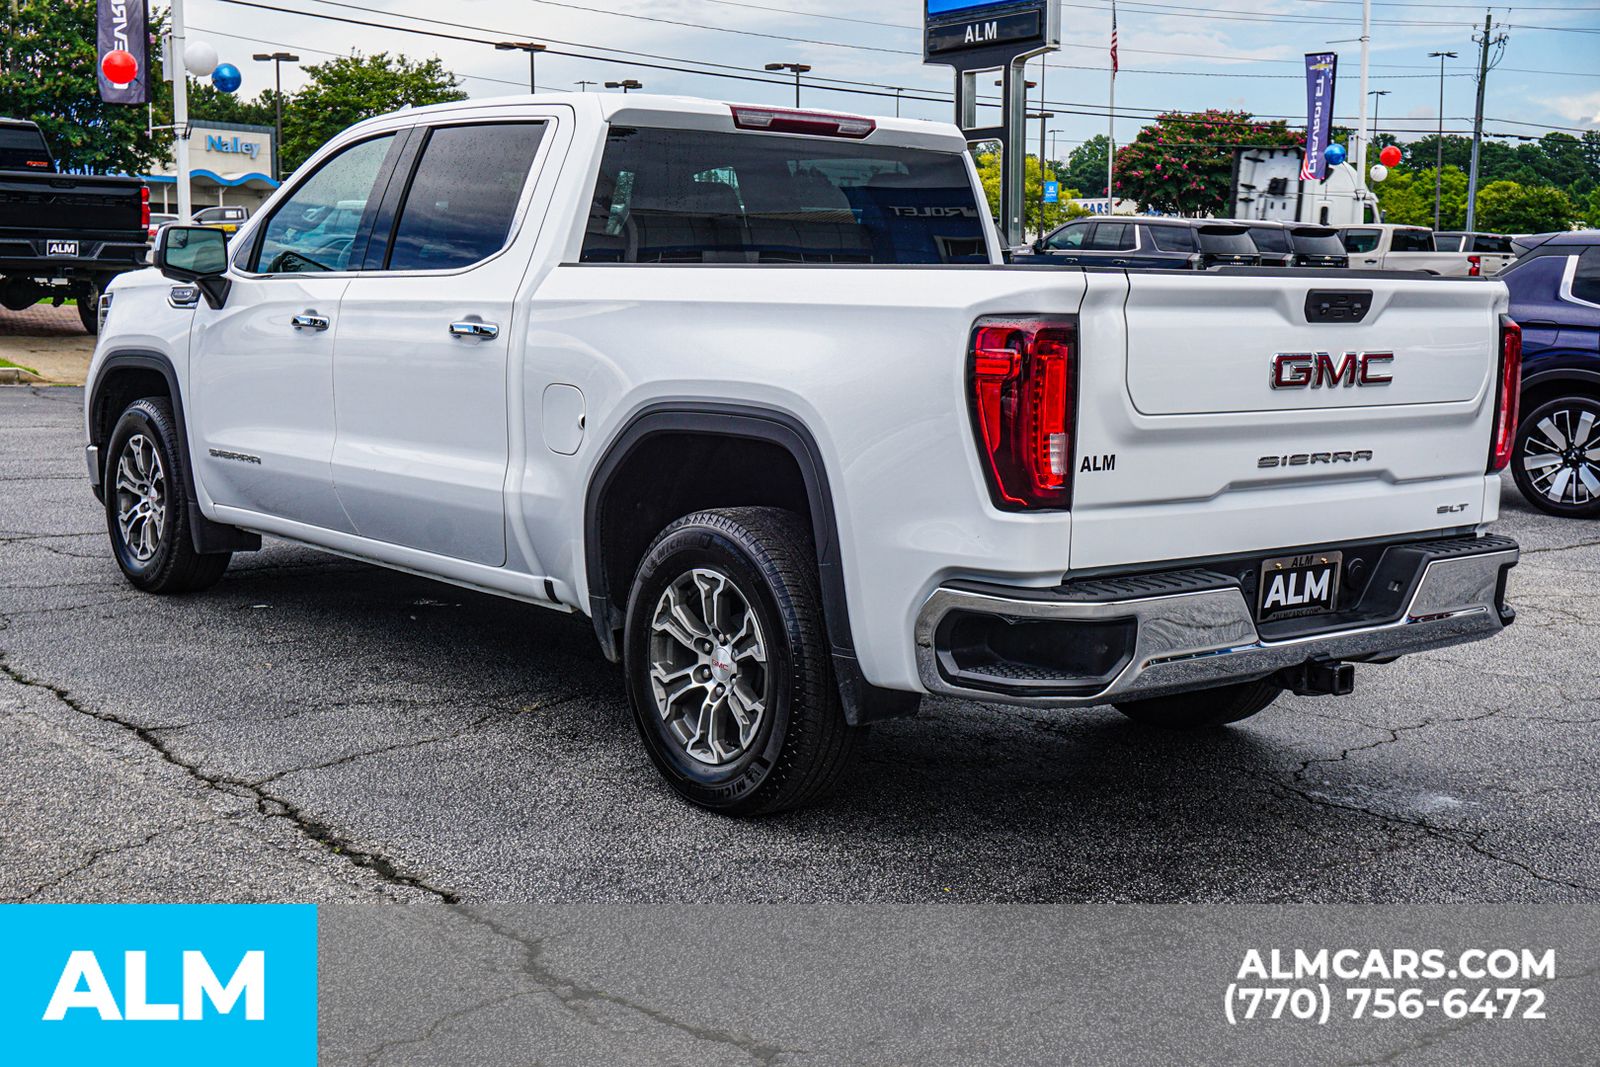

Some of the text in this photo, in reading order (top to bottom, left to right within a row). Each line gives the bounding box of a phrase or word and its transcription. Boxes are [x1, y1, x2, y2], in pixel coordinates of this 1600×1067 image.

[964, 21, 998, 43] ALM
[206, 135, 261, 159] Nalley
[50, 243, 75, 254] ALM
[1269, 350, 1394, 390] GMC
[1080, 454, 1116, 473] ALM
[1257, 450, 1373, 468] SIERRA
[1436, 503, 1469, 514] SLT
[1291, 555, 1314, 567] ALM
[1264, 569, 1331, 609] ALM
[712, 659, 729, 672] GMC
